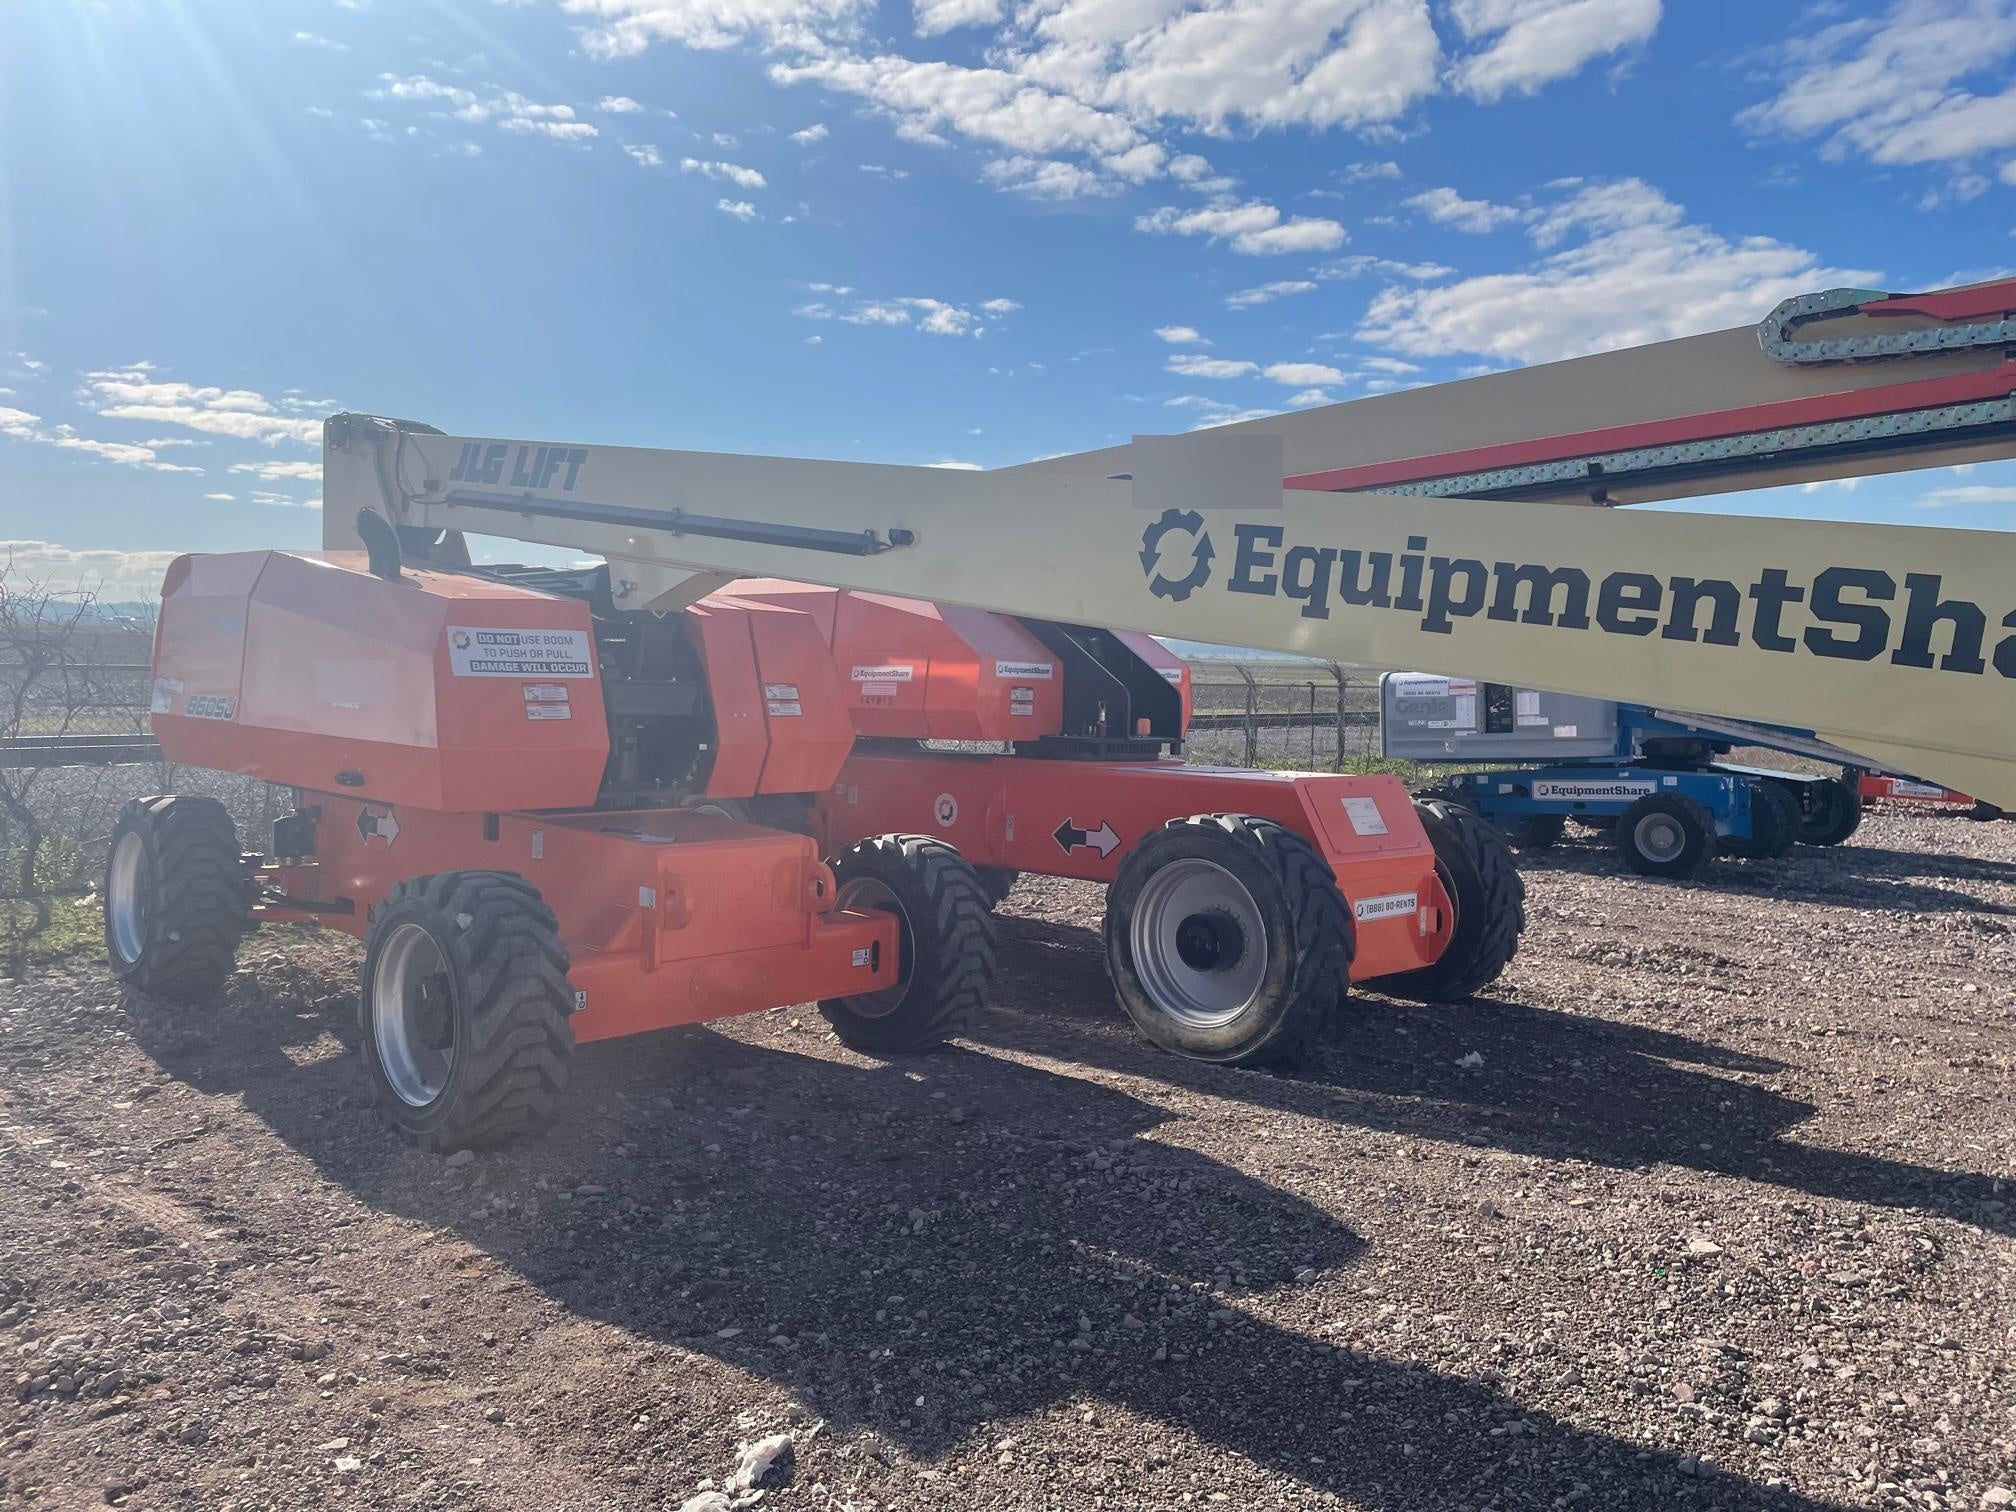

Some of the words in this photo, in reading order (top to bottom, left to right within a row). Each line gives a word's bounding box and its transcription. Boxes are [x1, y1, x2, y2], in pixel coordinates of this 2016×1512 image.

[448, 443, 509, 484] JLG
[510, 446, 589, 491] LIFT
[478, 633, 492, 645] DO
[496, 634, 519, 645] NOT
[521, 636, 541, 645] USE
[544, 636, 573, 645] BOOM
[483, 648, 496, 657] TO
[500, 648, 527, 658] PUSH
[530, 649, 544, 658] OR
[472, 661, 520, 672] DAMAGE
[521, 662, 550, 672] WILL
[550, 663, 587, 673] OCCUR
[1004, 665, 1050, 675] EquipmentShare
[860, 670, 910, 679] EquipmentShare
[186, 695, 238, 719] 860SJ
[1395, 698, 1449, 715] Genie
[1551, 785, 1650, 797] EquipmentShare
